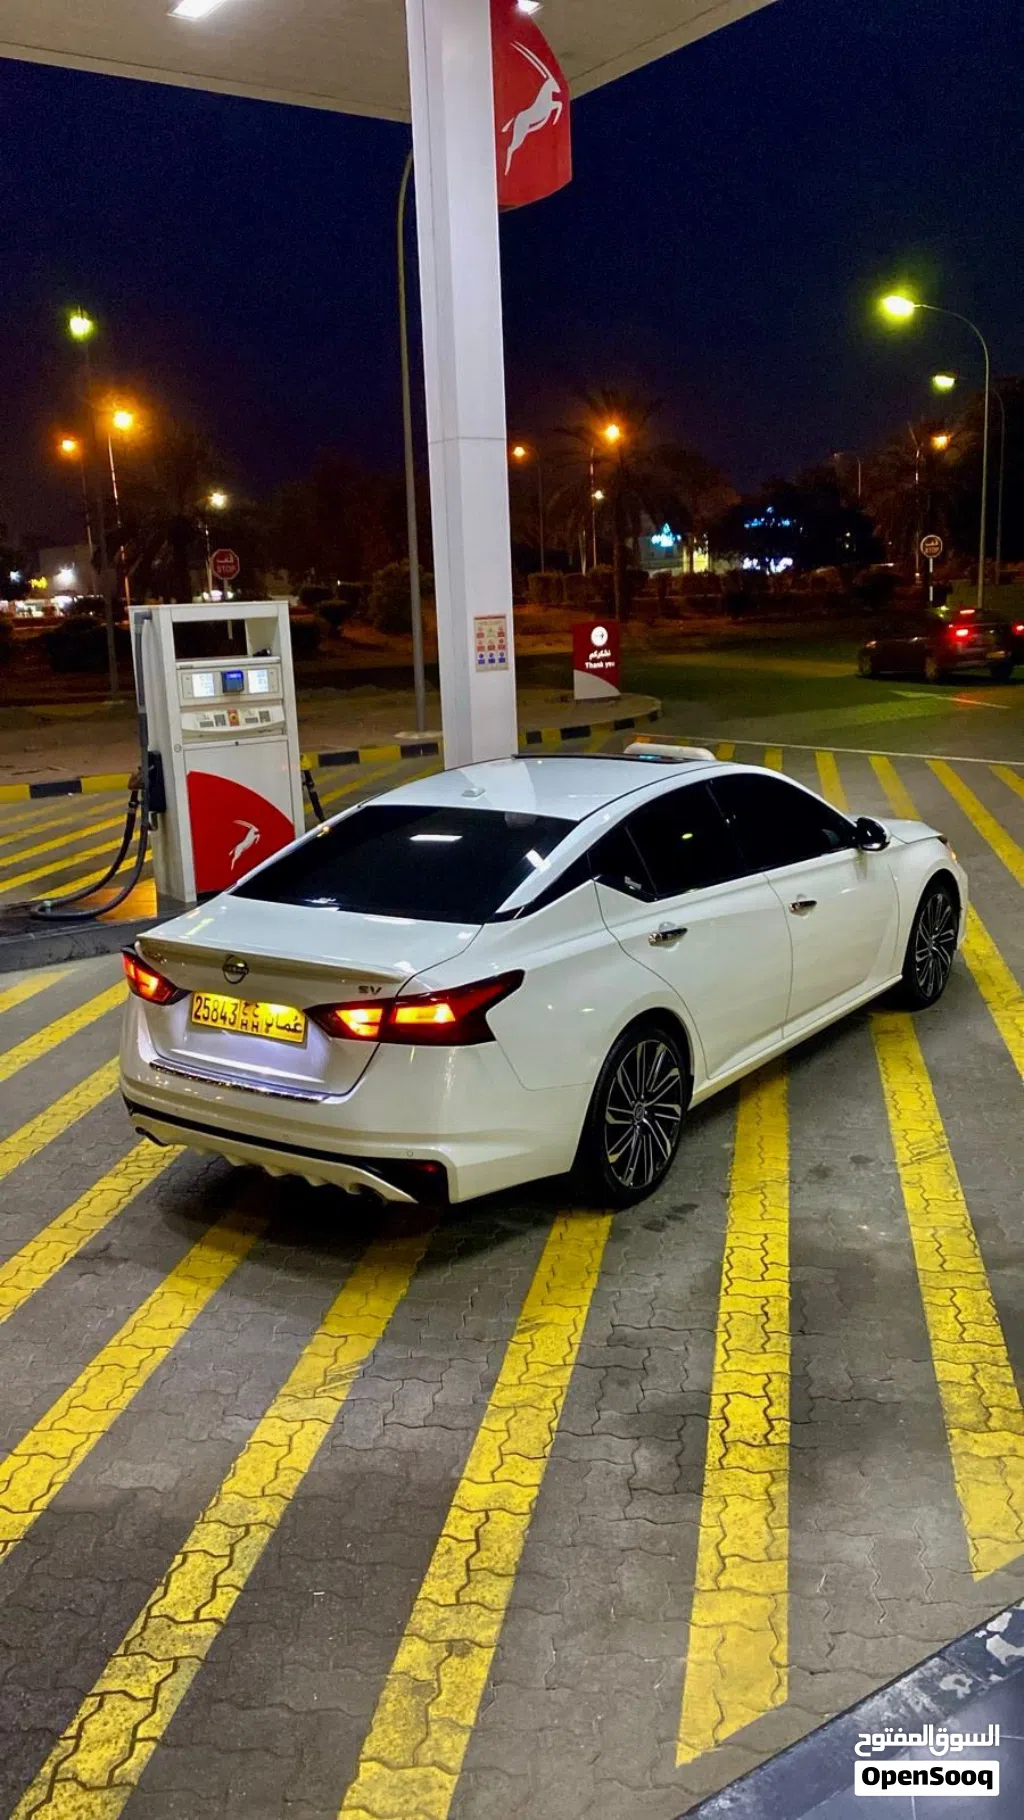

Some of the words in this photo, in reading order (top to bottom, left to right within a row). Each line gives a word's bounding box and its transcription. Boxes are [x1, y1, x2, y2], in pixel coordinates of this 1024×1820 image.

[584, 660, 604, 669] Thank
[604, 661, 616, 669] you
[358, 985, 382, 996] SV
[194, 995, 239, 1026] 25843
